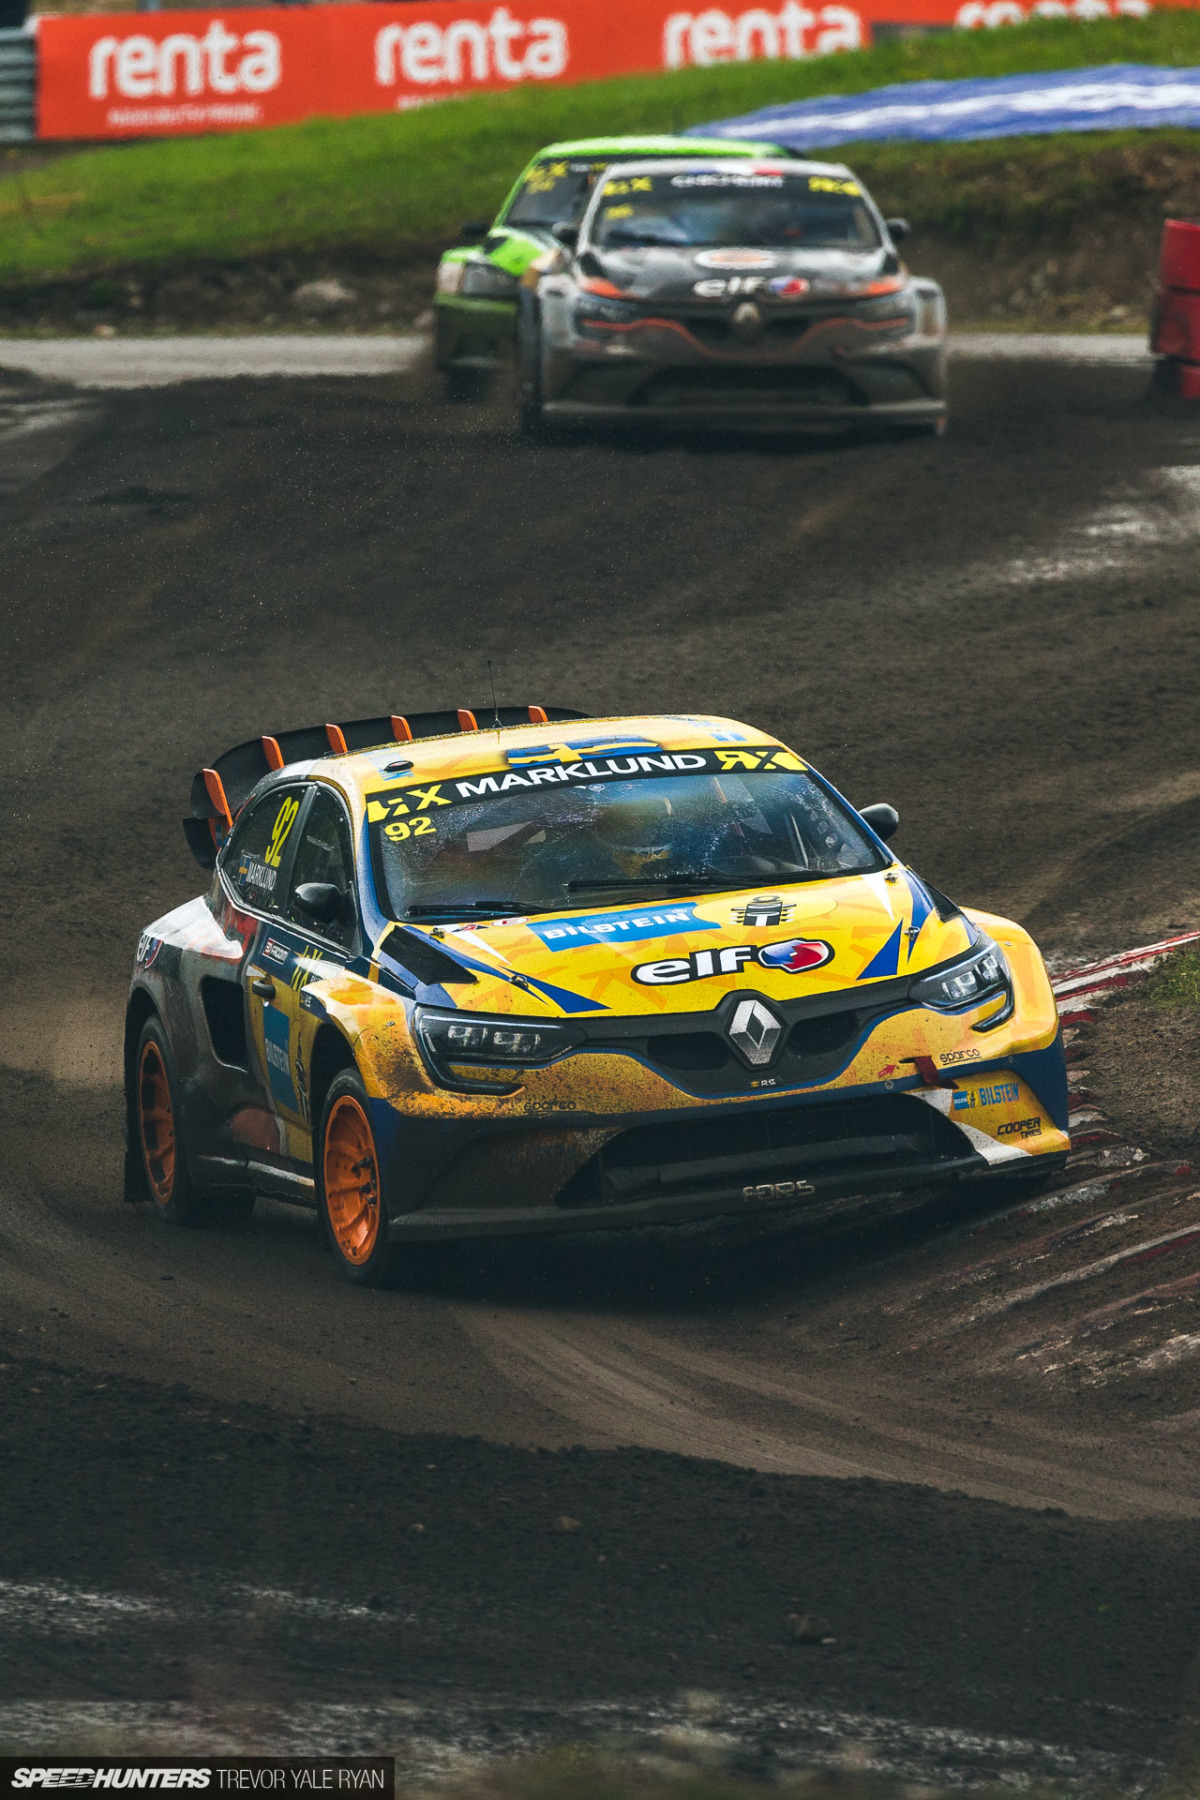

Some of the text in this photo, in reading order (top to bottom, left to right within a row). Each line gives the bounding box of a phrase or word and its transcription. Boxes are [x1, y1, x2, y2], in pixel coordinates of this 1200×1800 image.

[374, 6, 569, 88] renta
[663, 1, 862, 70] renta
[89, 20, 282, 100] renta
[693, 276, 765, 298] elf
[455, 754, 707, 799] MARKLUND
[264, 796, 300, 868] 92
[384, 816, 437, 842] 92
[542, 910, 689, 940] BILSTEIN
[635, 946, 752, 985] elf
[939, 1048, 981, 1065] sparco
[978, 1083, 1020, 1107] BILSTEIN
[997, 1117, 1042, 1136] COOPER
[1020, 1129, 1042, 1140] TIRES
